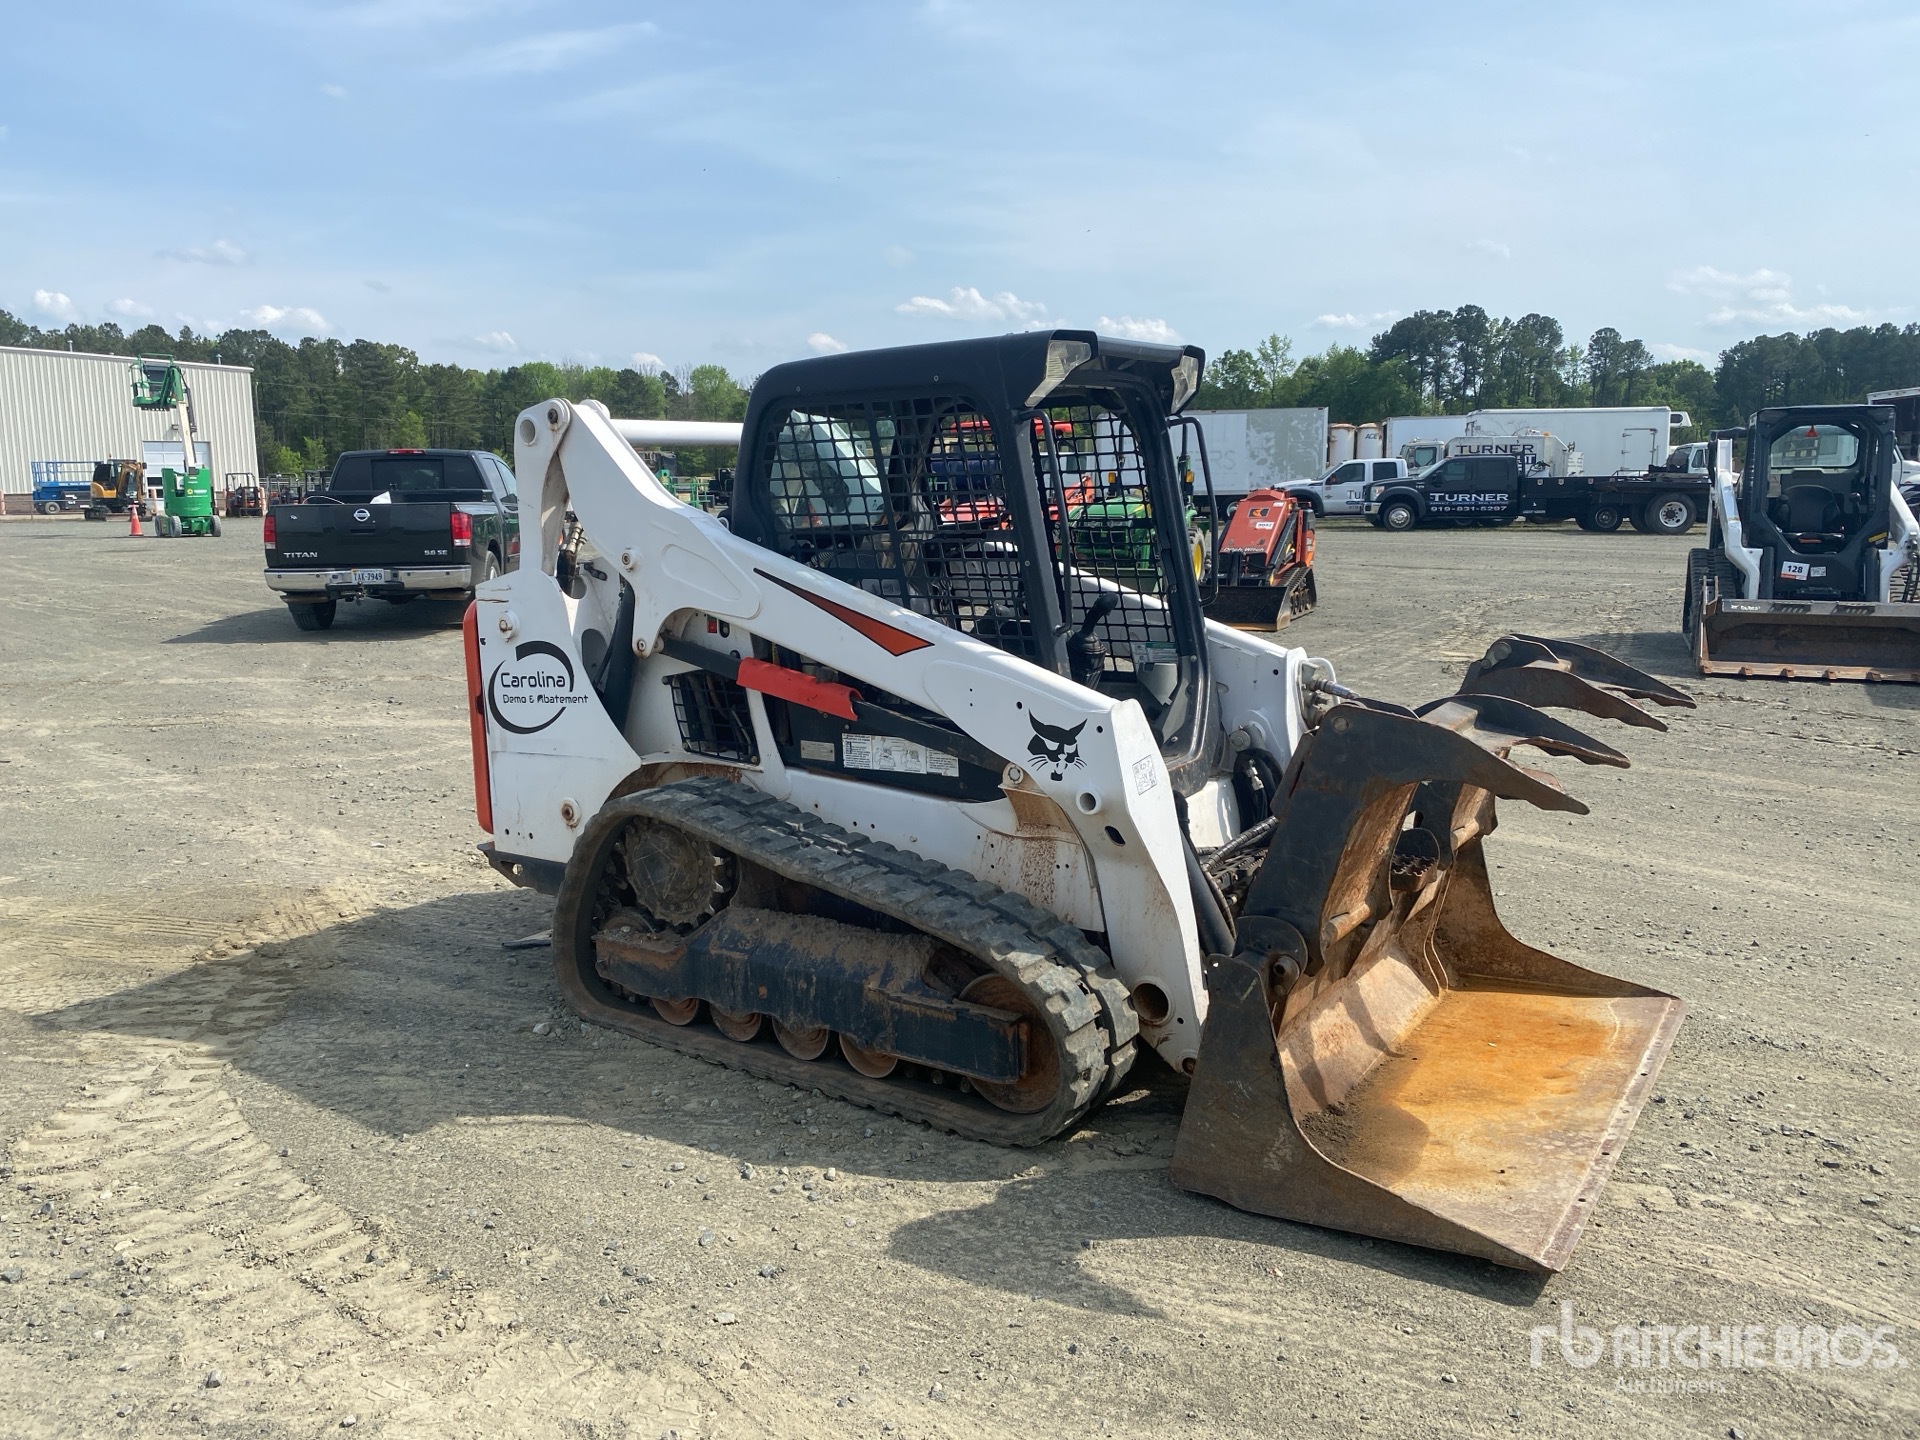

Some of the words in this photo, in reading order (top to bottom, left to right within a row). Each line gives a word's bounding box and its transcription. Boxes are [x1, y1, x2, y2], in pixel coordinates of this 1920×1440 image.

[1456, 444, 1534, 453] TURNER
[1429, 492, 1509, 502] TURNER
[1787, 565, 1803, 573] 128
[500, 671, 566, 688] Carolina
[503, 694, 527, 704] Demo
[529, 694, 535, 704] &
[537, 694, 589, 704] Abatement
